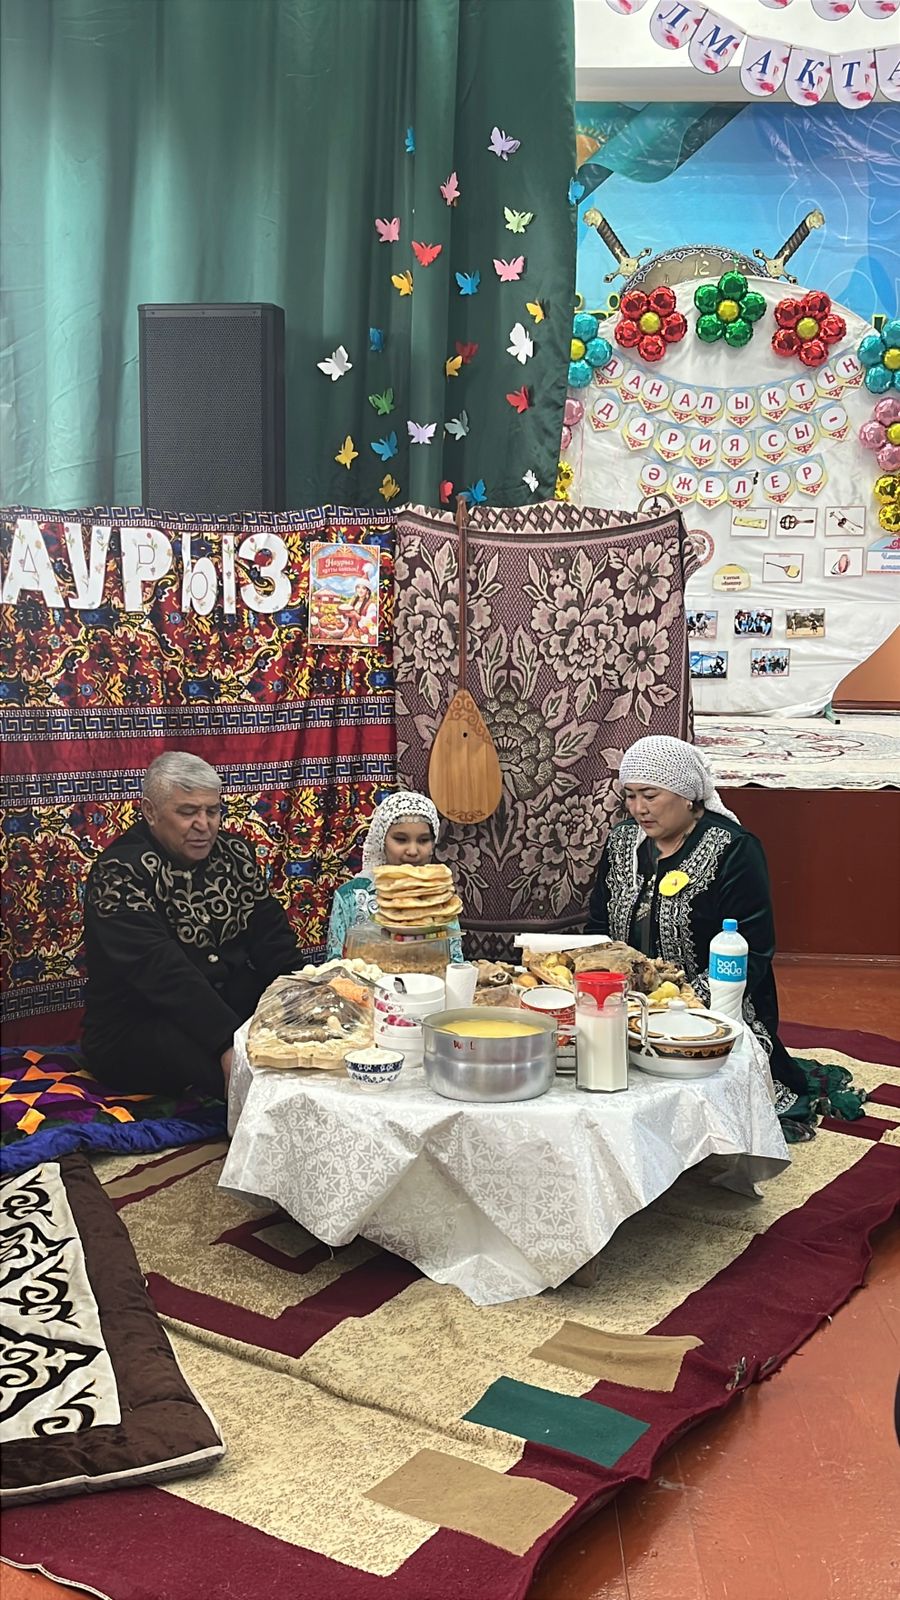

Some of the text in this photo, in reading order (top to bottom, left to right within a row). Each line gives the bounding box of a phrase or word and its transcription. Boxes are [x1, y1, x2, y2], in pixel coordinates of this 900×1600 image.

[693, 260, 710, 276] 12
[597, 403, 810, 452] ДАРИЯСЫ
[648, 466, 812, 494] ӘЖЕЛЕР
[716, 957, 737, 968] bon
[716, 966, 742, 976] aqua
